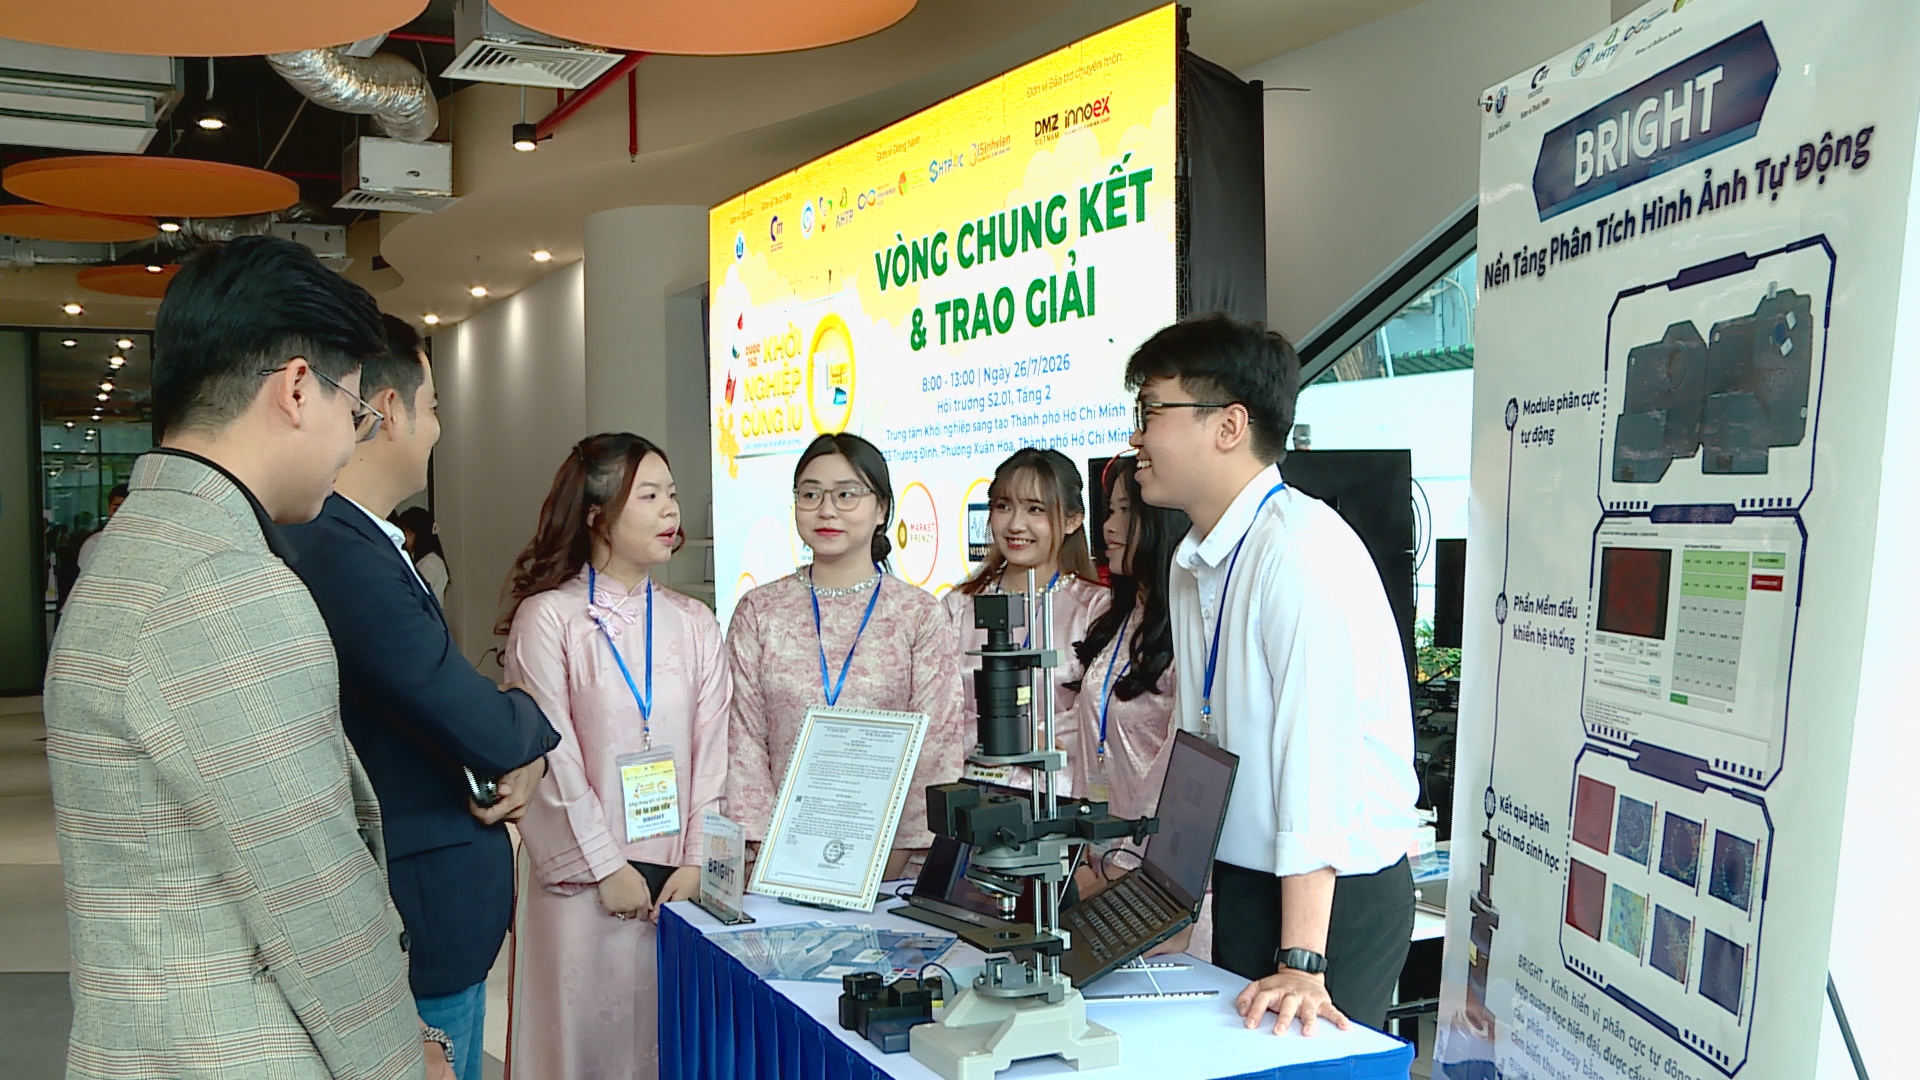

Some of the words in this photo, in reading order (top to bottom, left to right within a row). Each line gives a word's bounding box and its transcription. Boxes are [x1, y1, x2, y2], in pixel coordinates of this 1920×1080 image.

[1034, 113, 1059, 138] DMZ
[1064, 95, 1111, 129] innoex
[1573, 64, 1725, 188] BRIGHT
[874, 233, 948, 291] VÒNG
[957, 194, 1067, 269] CHUNG
[1079, 152, 1153, 238] KẾT
[1484, 252, 1510, 290] Nền
[1513, 245, 1547, 277] Tảng
[1550, 226, 1592, 265] Phân
[1597, 209, 1636, 248] Tích
[1641, 189, 1692, 234] Hình
[1697, 168, 1747, 215] Ảnh
[1755, 154, 1790, 201] Tự
[1794, 125, 1875, 185] Động
[910, 308, 927, 351] &
[935, 286, 1015, 345] TRAO
[1025, 250, 1095, 328] GIẢI
[763, 321, 803, 363] KHỞI
[922, 375, 942, 393] 8:00
[950, 369, 975, 388] 13:00
[983, 363, 1011, 386] Ngày
[1014, 353, 1071, 380] 26/7/2026
[937, 398, 952, 416] Hội
[987, 390, 1014, 407] S2.01,
[1045, 384, 1051, 400] 2
[1522, 395, 1555, 416] Module
[1556, 390, 1580, 415] phân
[1581, 390, 1600, 411] cực
[741, 404, 785, 438] CÙNG
[886, 429, 907, 442] Trung
[972, 416, 993, 434] sáng
[1011, 410, 1039, 426] Thành
[1042, 407, 1061, 427] phố
[1079, 404, 1096, 421] Chí
[1099, 402, 1126, 419] Minh
[1521, 429, 1532, 448] tự
[1532, 425, 1555, 447] động
[974, 440, 995, 455] Xuân
[1088, 428, 1105, 445] Chí
[1537, 627, 1547, 651] hệ
[1549, 627, 1575, 655] thống
[1500, 794, 1513, 816] Kết
[1513, 804, 1528, 823] quả
[1529, 811, 1549, 834] phân
[1497, 824, 1512, 846] tích
[1512, 834, 1525, 852] mô
[1525, 839, 1543, 863] sinh
[1544, 847, 1560, 874] học
[708, 857, 735, 885] BRIGHT
[1518, 953, 1544, 983] BRIGHT
[1550, 977, 1569, 1002] Kính
[1571, 990, 1590, 1017] hiển
[1601, 1016, 1626, 1042] phân
[1628, 1035, 1646, 1057] cực
[1649, 1046, 1662, 1072] tự
[1529, 993, 1551, 1021] quang
[1551, 1006, 1566, 1032] học
[1567, 1017, 1585, 1044] hiện
[1586, 1032, 1602, 1059] đại,
[1603, 1046, 1627, 1075] được
[1542, 1055, 1556, 1077] thu
[1561, 1046, 1581, 1072] xoay
